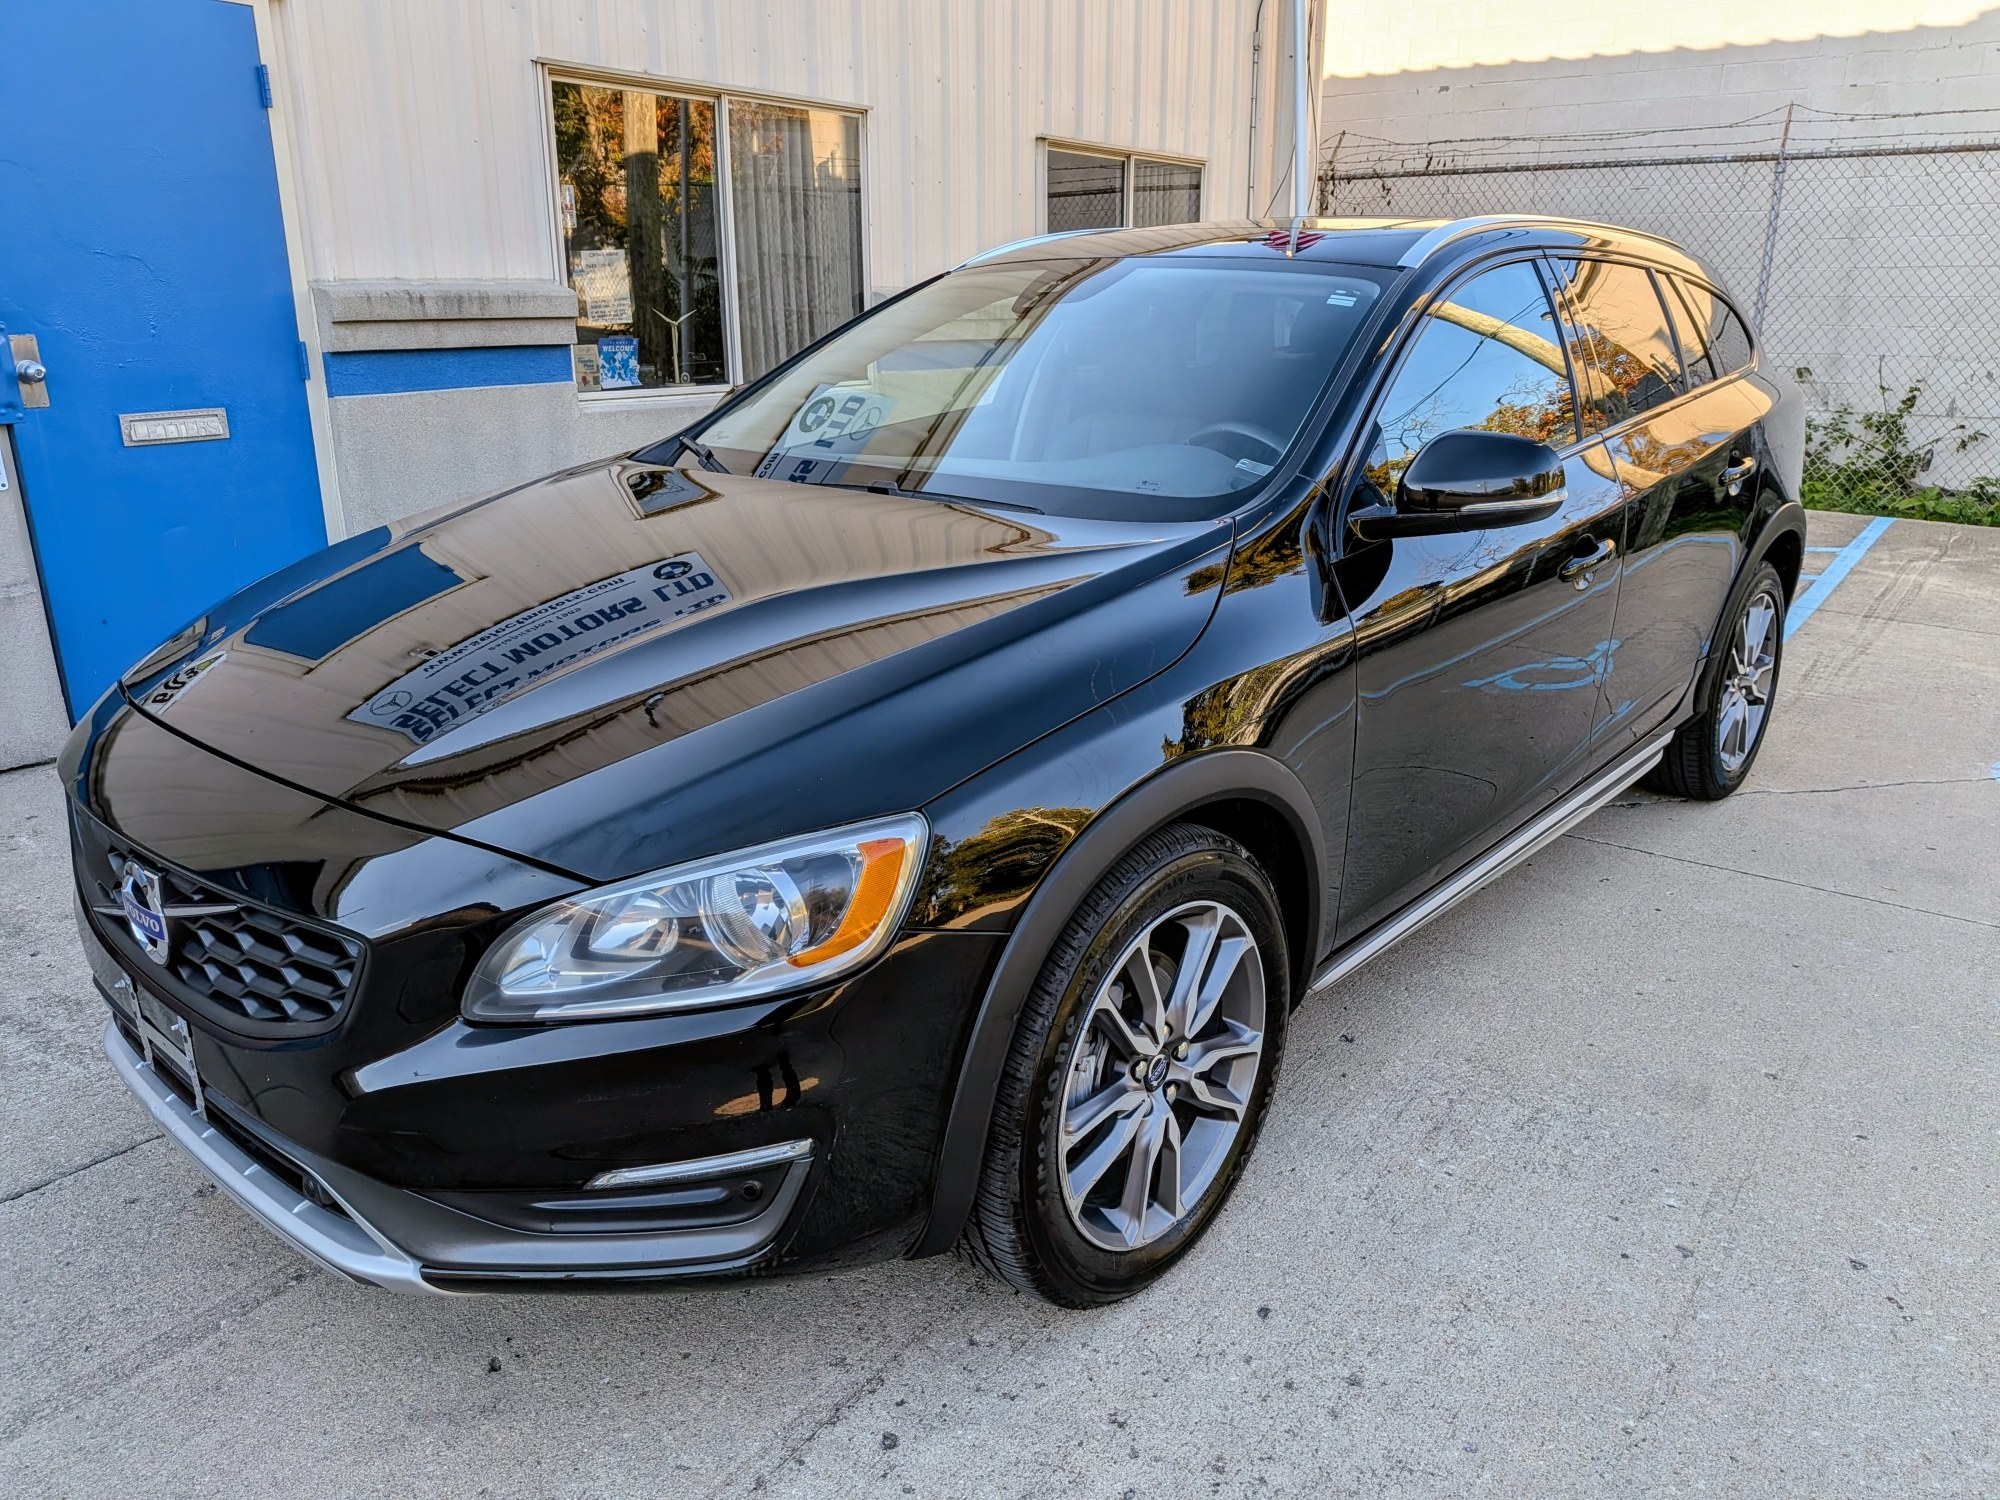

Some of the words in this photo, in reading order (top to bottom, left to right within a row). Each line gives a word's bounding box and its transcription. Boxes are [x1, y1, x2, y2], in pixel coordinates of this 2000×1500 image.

[132, 419, 220, 441] LETTERS
[125, 902, 160, 933] VOLVO
[1035, 1014, 1077, 1213] Firestone
